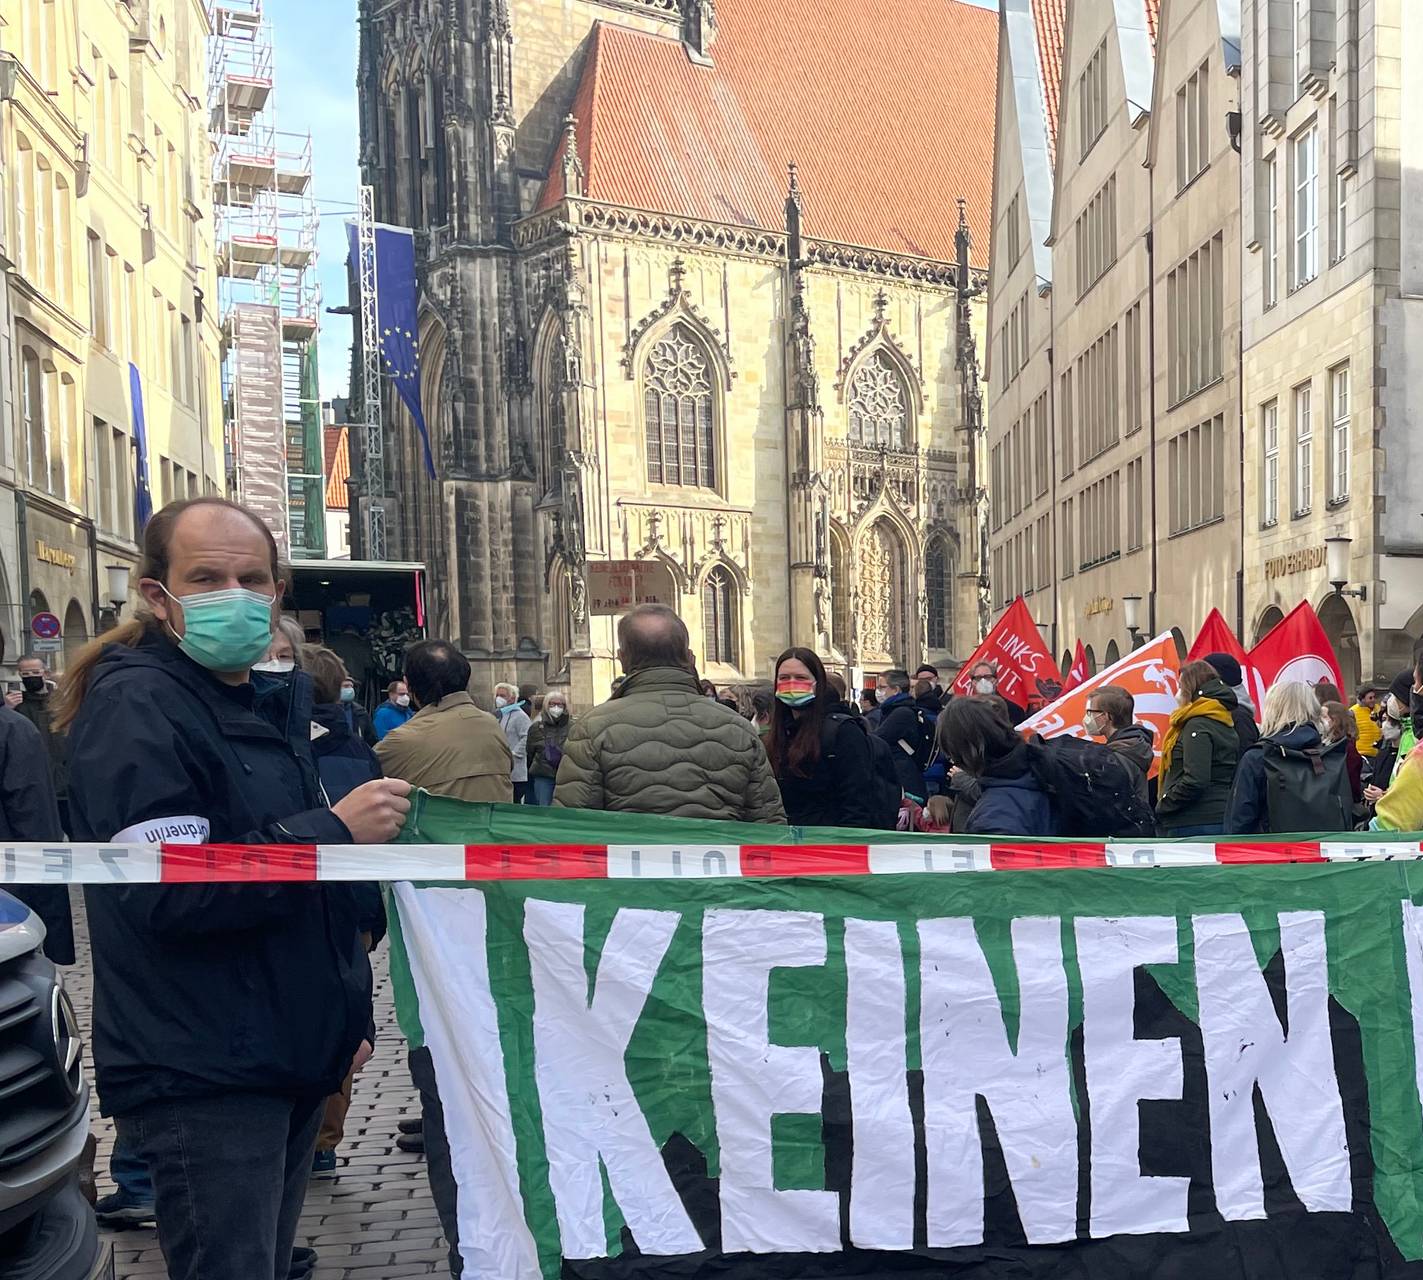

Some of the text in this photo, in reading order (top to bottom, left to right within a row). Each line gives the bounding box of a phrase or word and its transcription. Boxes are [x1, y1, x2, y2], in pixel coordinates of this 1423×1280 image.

[1265, 555, 1286, 580] FOTO
[996, 628, 1044, 677] LINKS.
[523, 897, 1353, 1258] KEINEN
